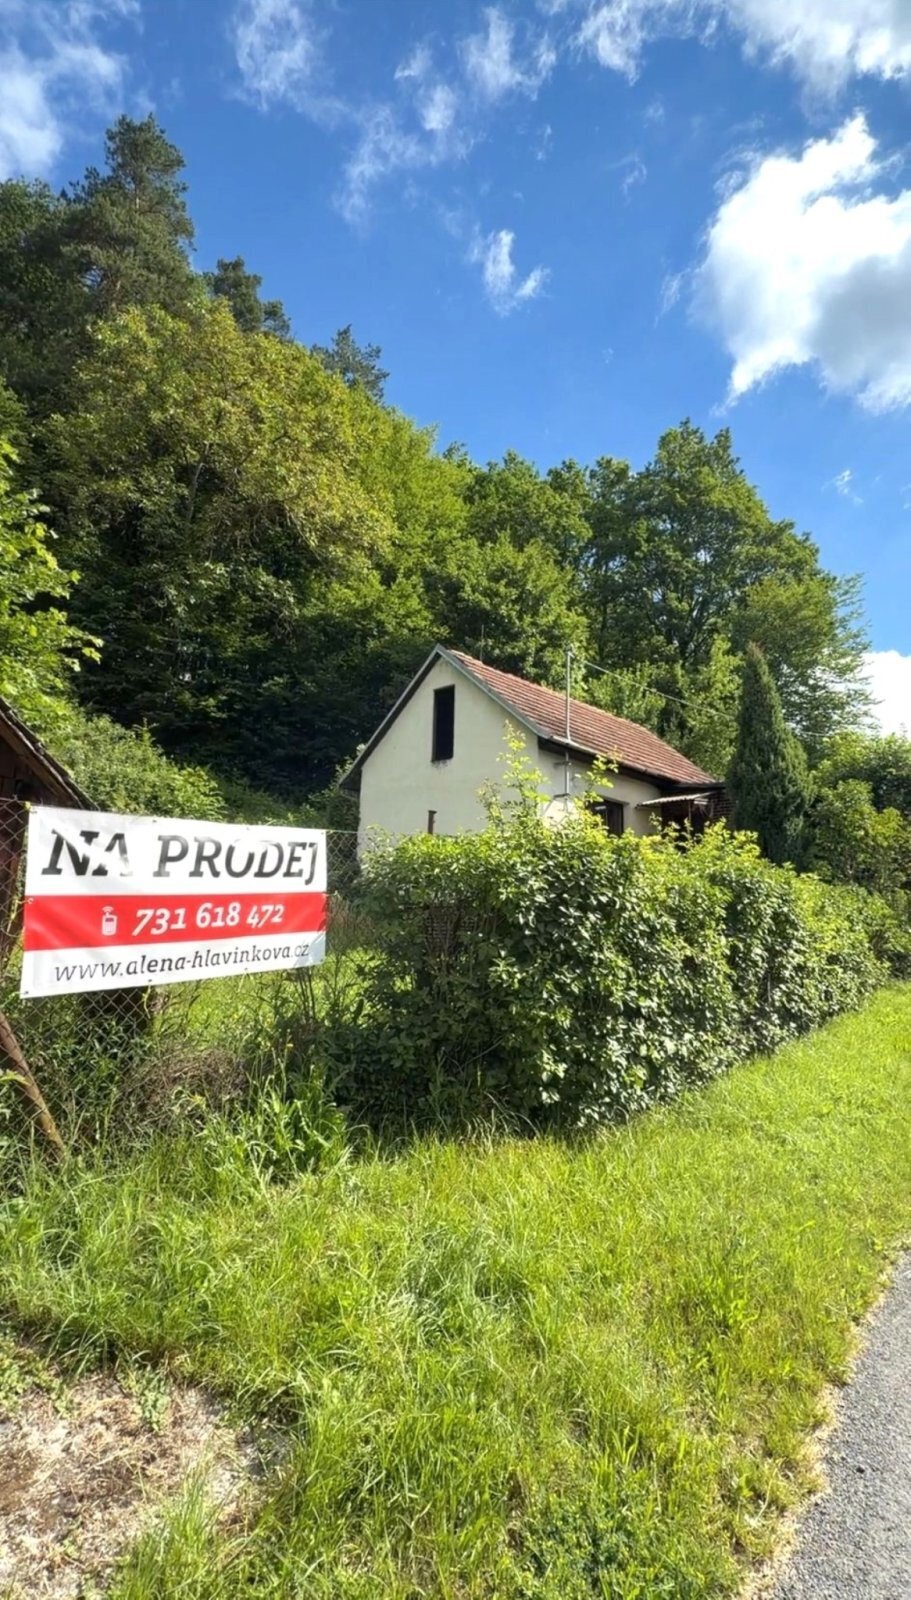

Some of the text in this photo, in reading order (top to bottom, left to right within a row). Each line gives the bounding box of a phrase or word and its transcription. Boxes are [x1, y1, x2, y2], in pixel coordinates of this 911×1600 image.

[41, 828, 319, 886] NA PRODEJ
[131, 902, 285, 937] 731 618 472
[54, 943, 310, 982] www.alena-hlavinkova.cz
